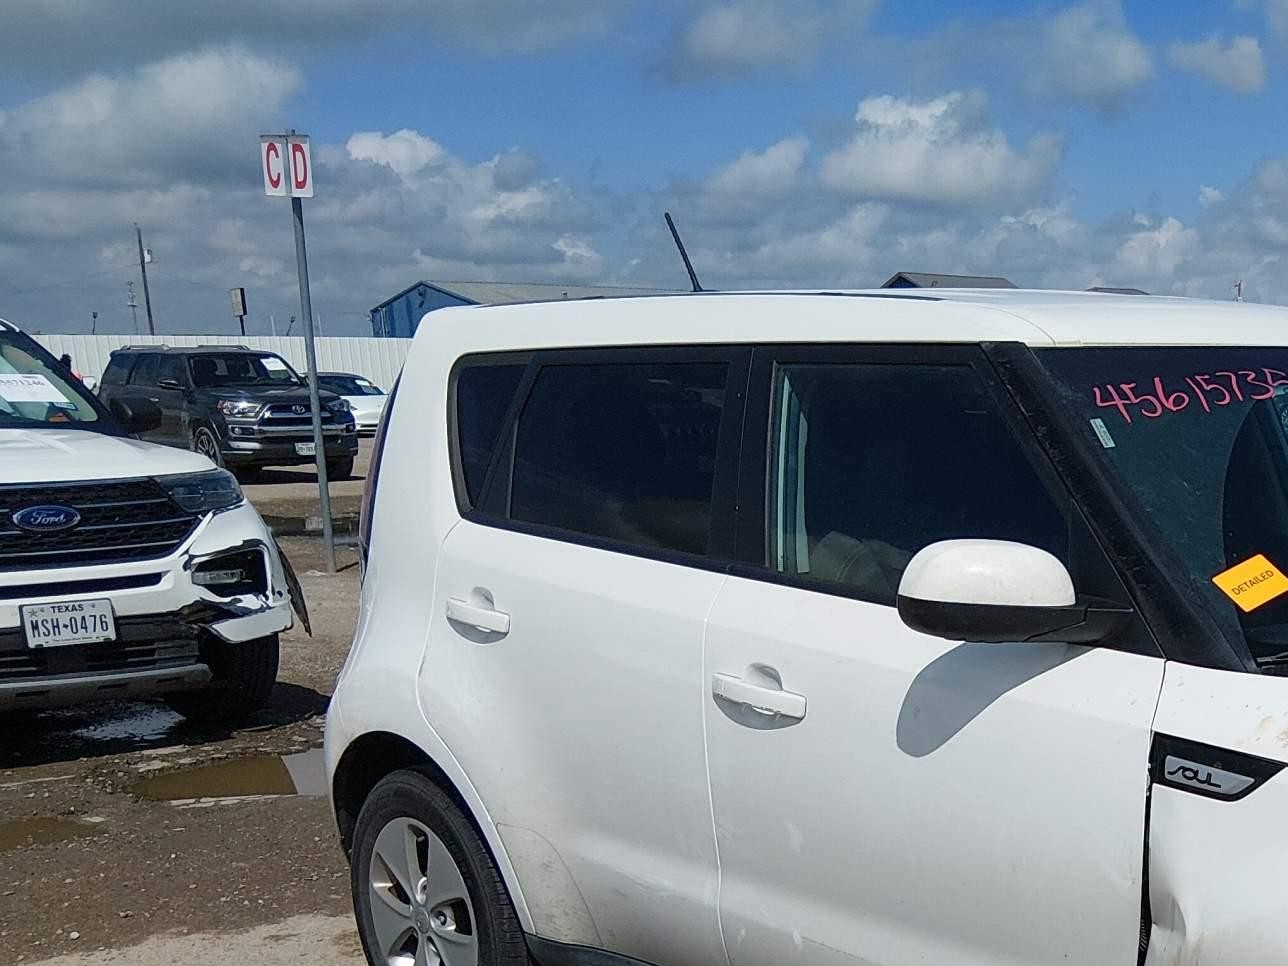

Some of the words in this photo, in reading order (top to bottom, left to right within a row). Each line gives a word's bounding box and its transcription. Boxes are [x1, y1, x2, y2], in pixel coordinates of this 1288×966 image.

[266, 142, 281, 189] C
[291, 143, 308, 190] D
[30, 509, 67, 525] Ford
[1231, 569, 1275, 596] DETAILED
[50, 603, 84, 614] TEXAS
